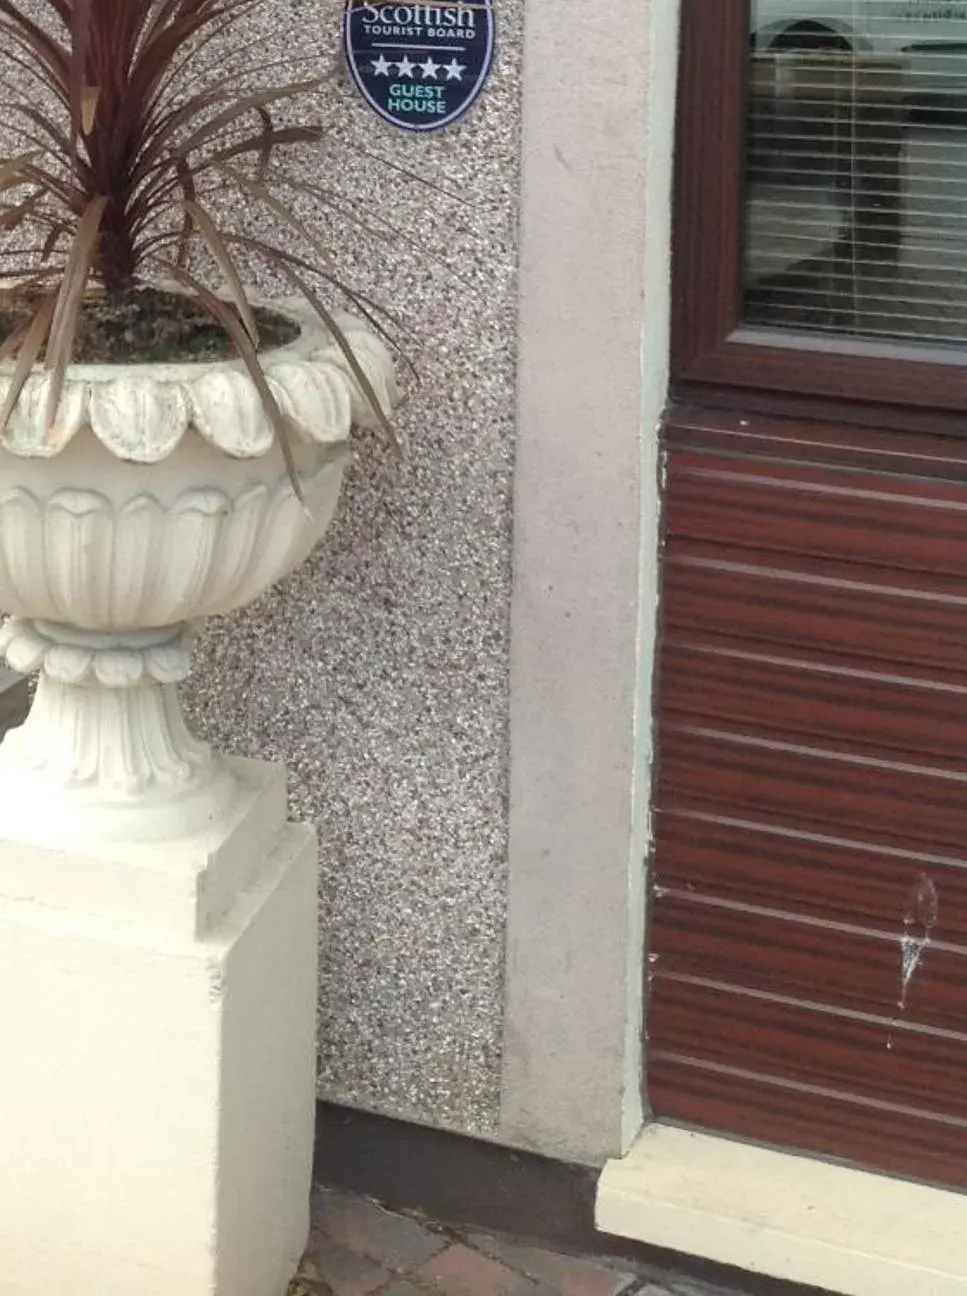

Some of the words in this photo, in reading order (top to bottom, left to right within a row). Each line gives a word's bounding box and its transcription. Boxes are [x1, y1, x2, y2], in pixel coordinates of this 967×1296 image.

[362, 1, 476, 27] Scottish
[365, 25, 421, 36] TOURIST
[427, 27, 476, 39] BOARD
[389, 84, 444, 99] GUEST
[388, 99, 446, 114] HOUSE
